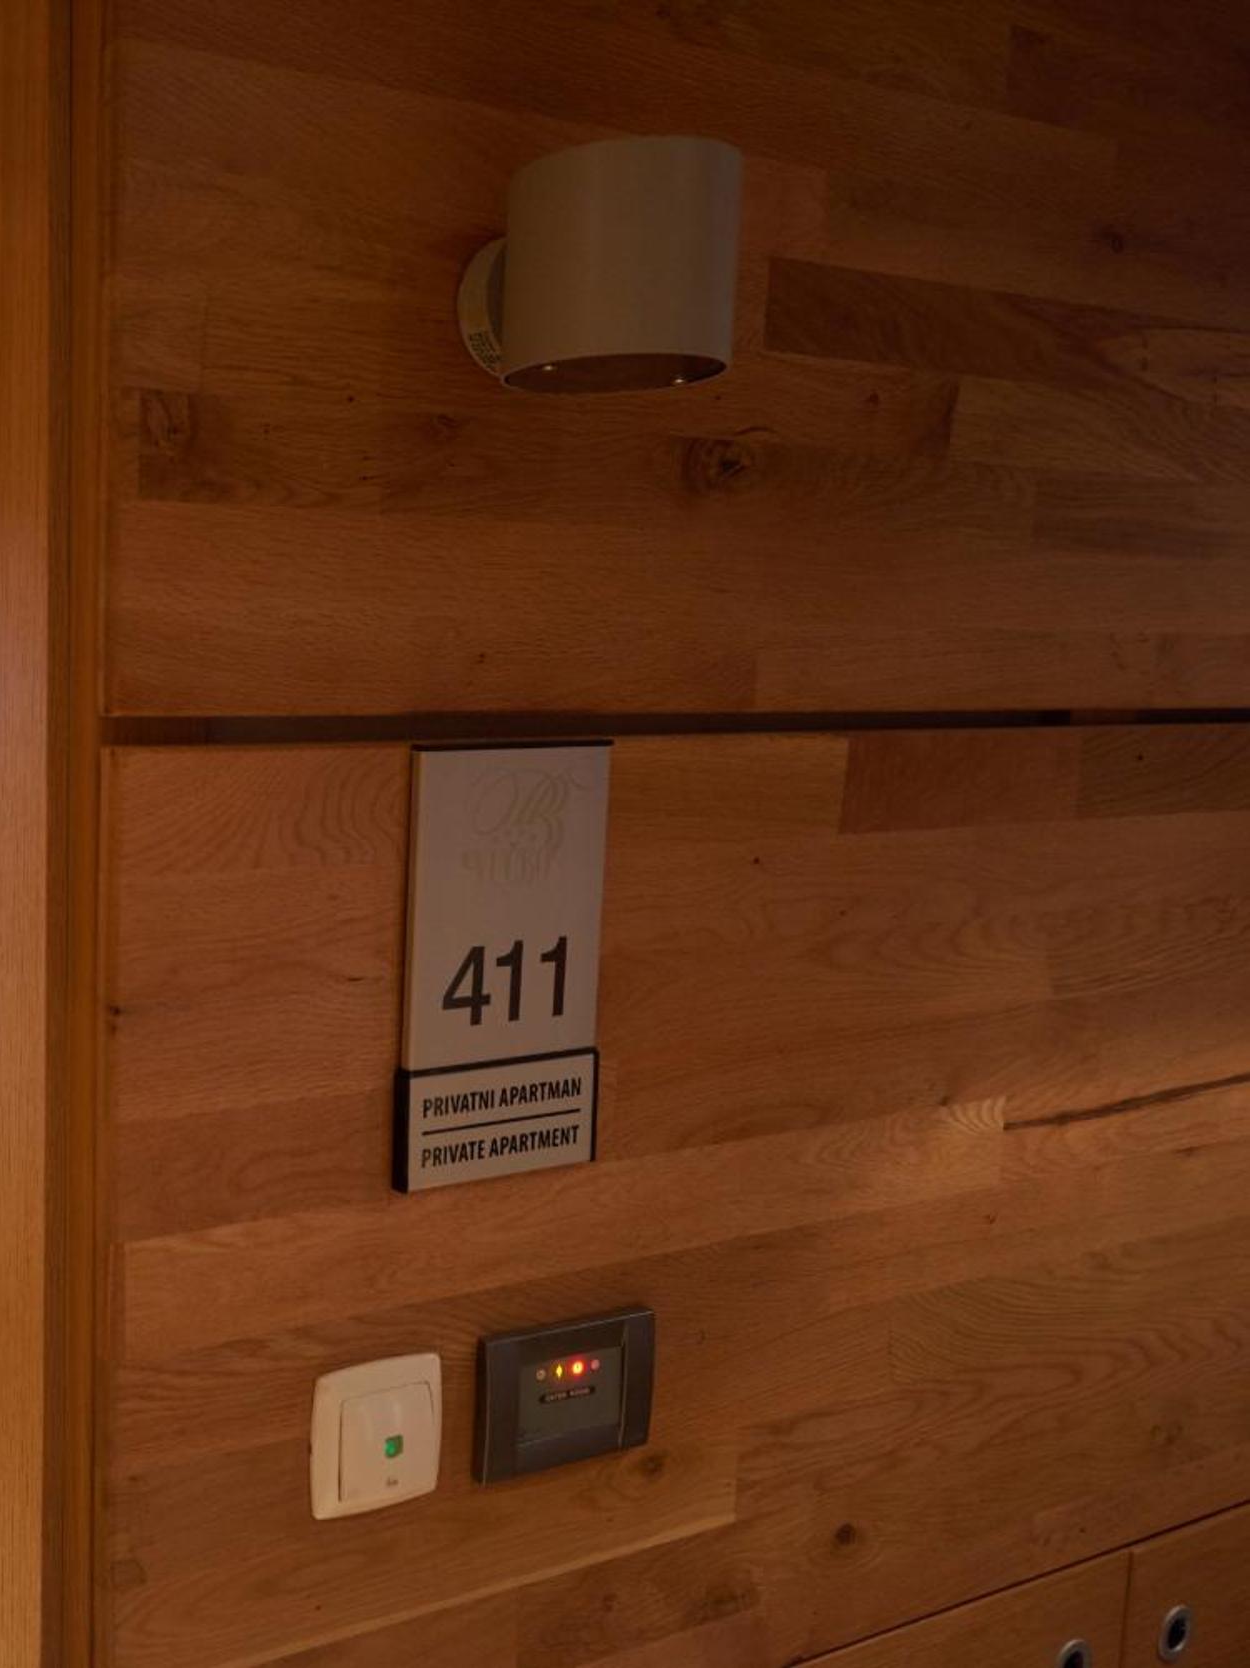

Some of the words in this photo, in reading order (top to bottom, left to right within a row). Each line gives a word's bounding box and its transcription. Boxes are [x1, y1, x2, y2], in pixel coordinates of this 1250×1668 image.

[442, 935, 568, 1026] 411
[423, 1089, 495, 1118] PRIVATNI
[499, 1077, 582, 1107] APARTMAN
[421, 1140, 485, 1168] PRIVATE
[489, 1125, 580, 1157] APARTMENT
